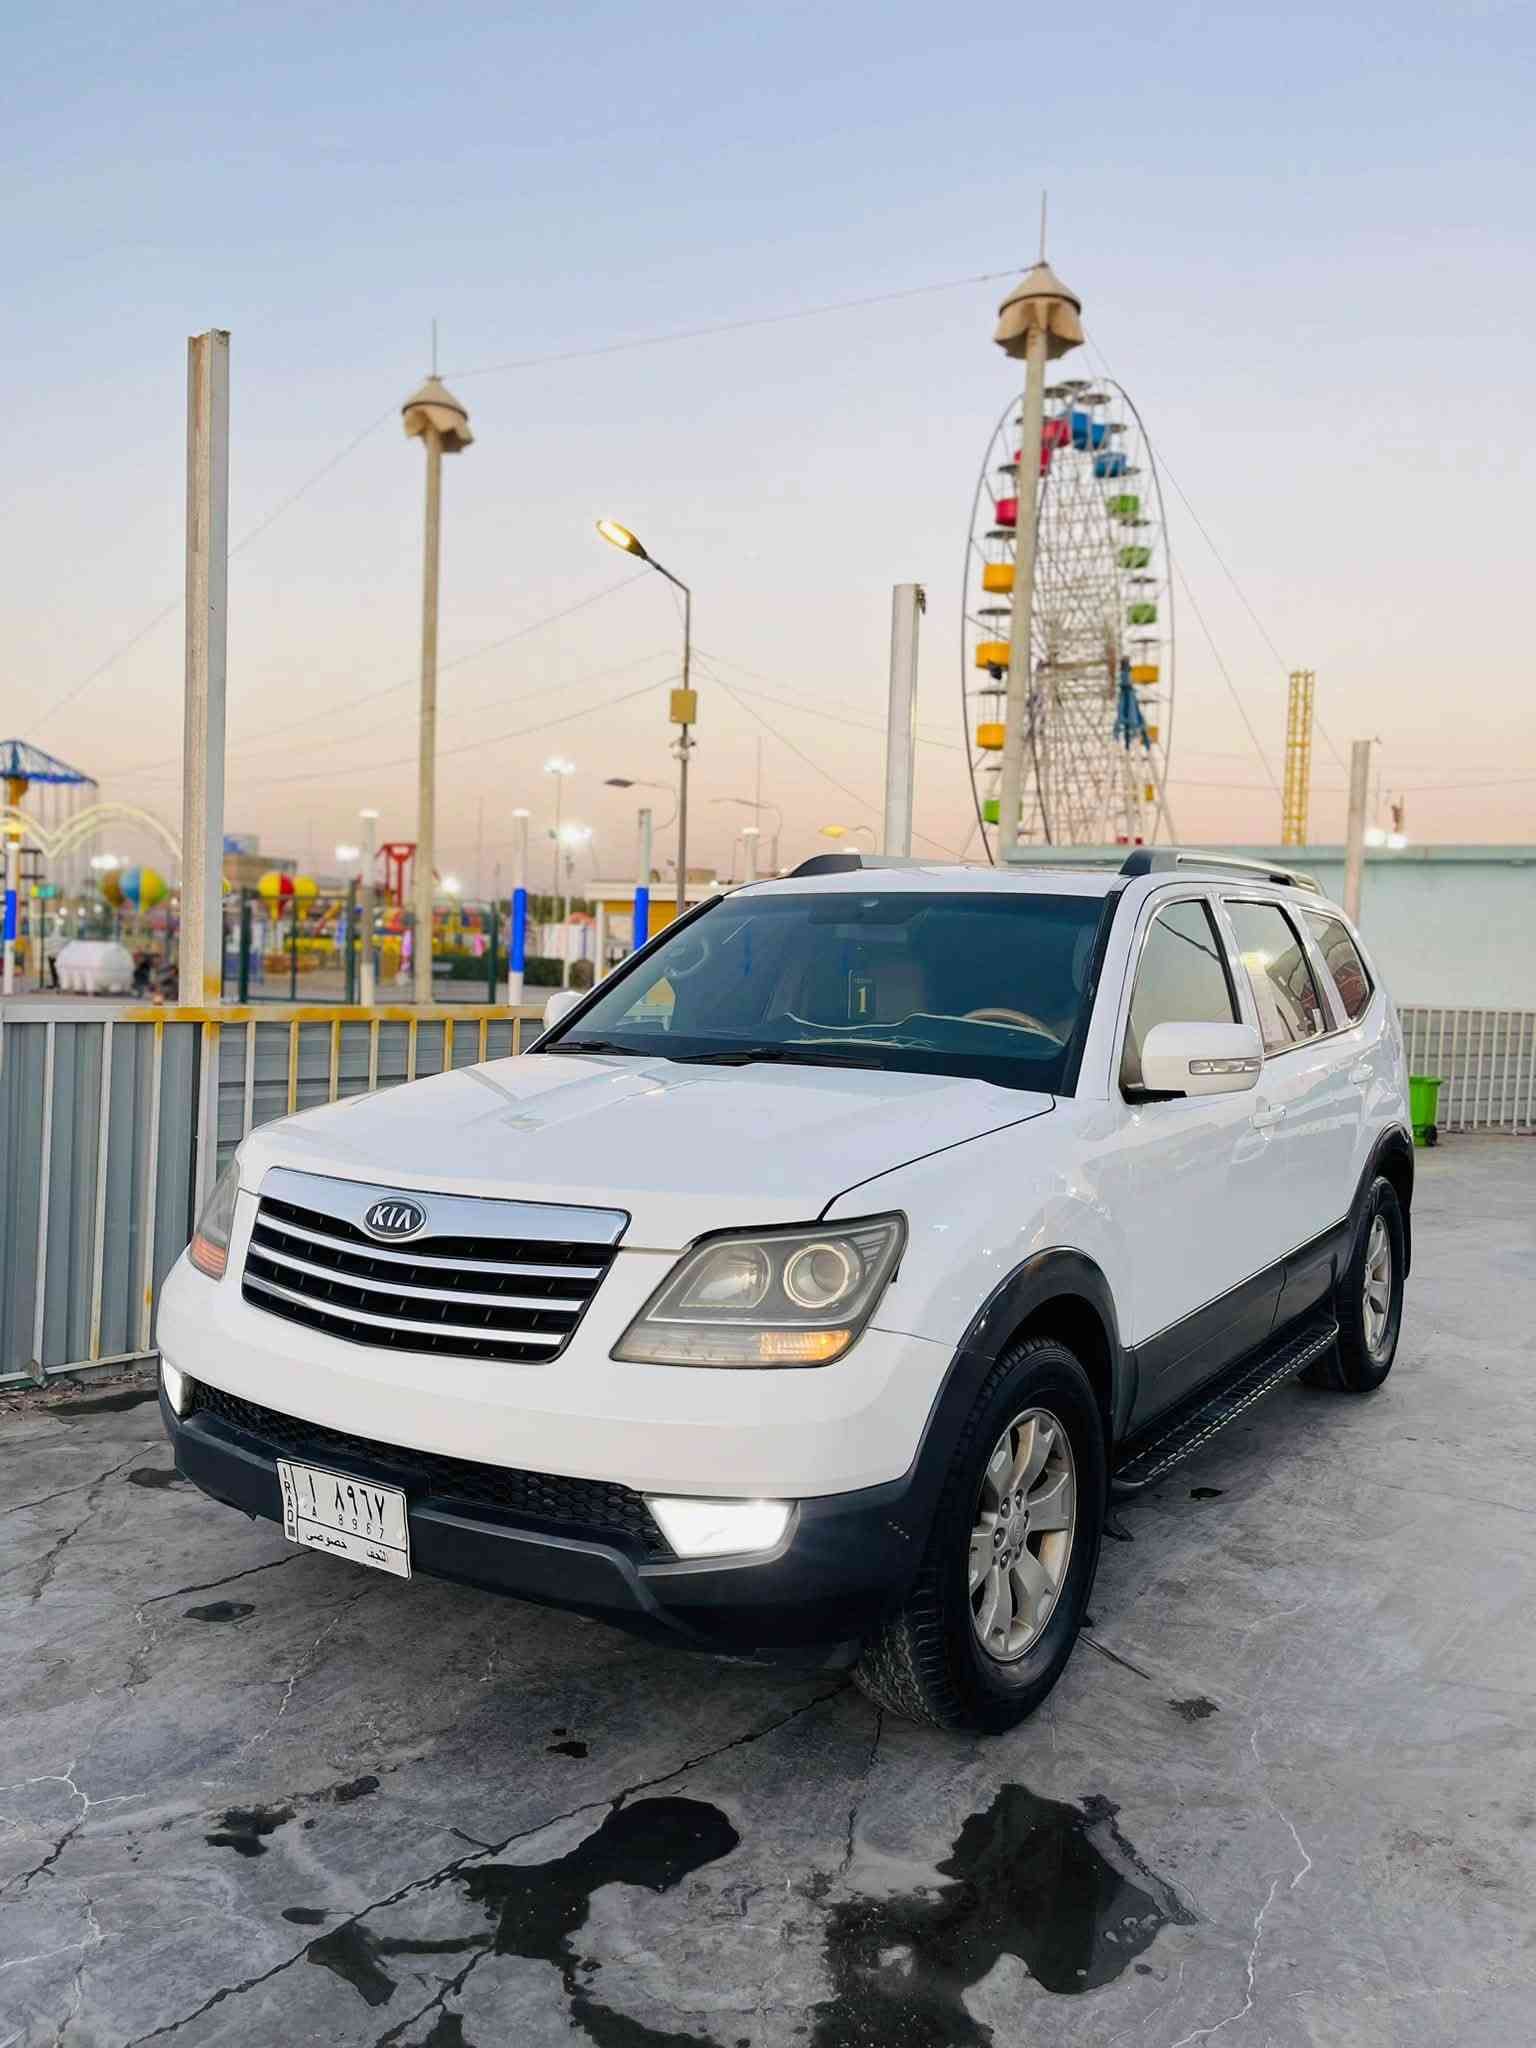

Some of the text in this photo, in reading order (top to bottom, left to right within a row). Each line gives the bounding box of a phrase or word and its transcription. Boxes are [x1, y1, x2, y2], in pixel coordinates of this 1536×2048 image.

[372, 1205, 412, 1230] KIA
[335, 1481, 384, 1525] ٨٩٦٧
[338, 1513, 384, 1539] 8967
